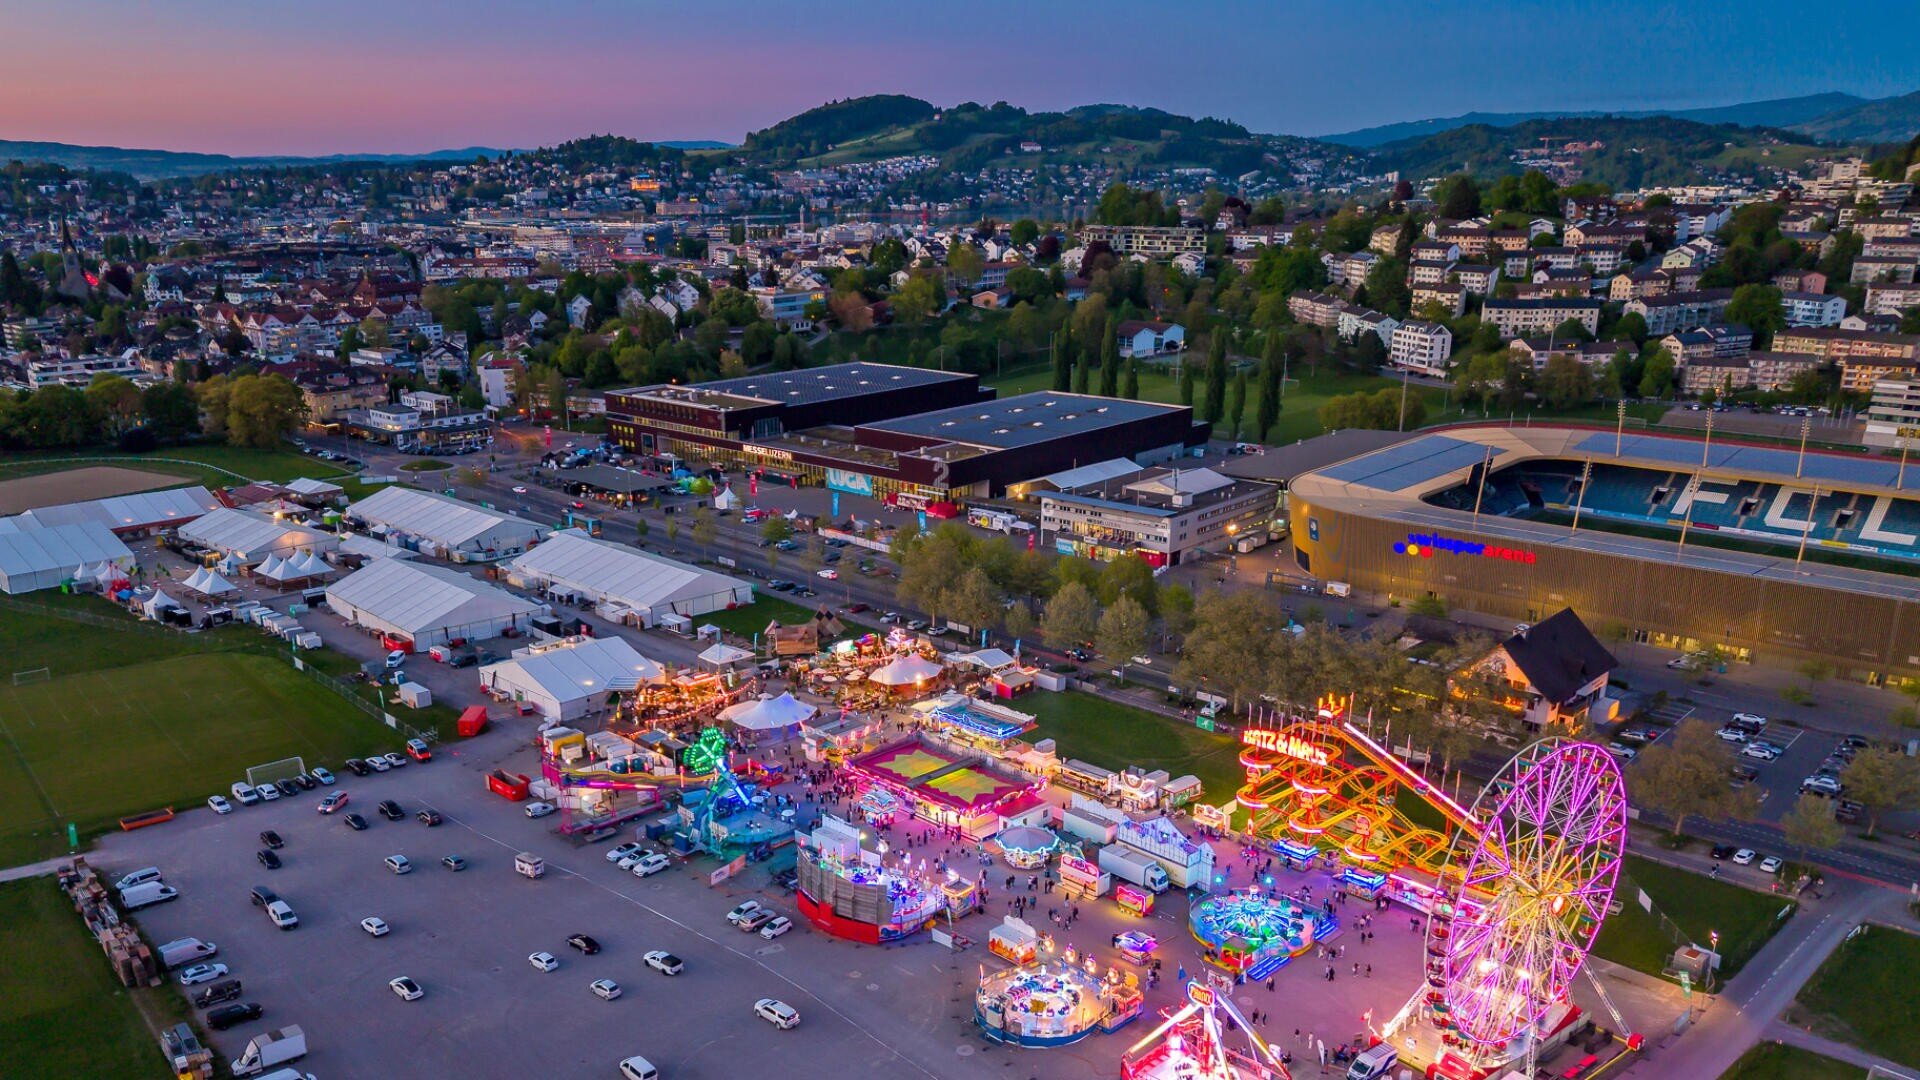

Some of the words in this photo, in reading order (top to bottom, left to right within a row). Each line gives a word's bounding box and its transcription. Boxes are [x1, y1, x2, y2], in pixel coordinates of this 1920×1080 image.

[932, 457, 950, 490] 2
[1671, 477, 1917, 546] FCL
[1408, 532, 1537, 565] swissporarena
[1243, 730, 1276, 752] KATZ
[1276, 734, 1288, 754] &
[1288, 736, 1328, 766] MAUS
